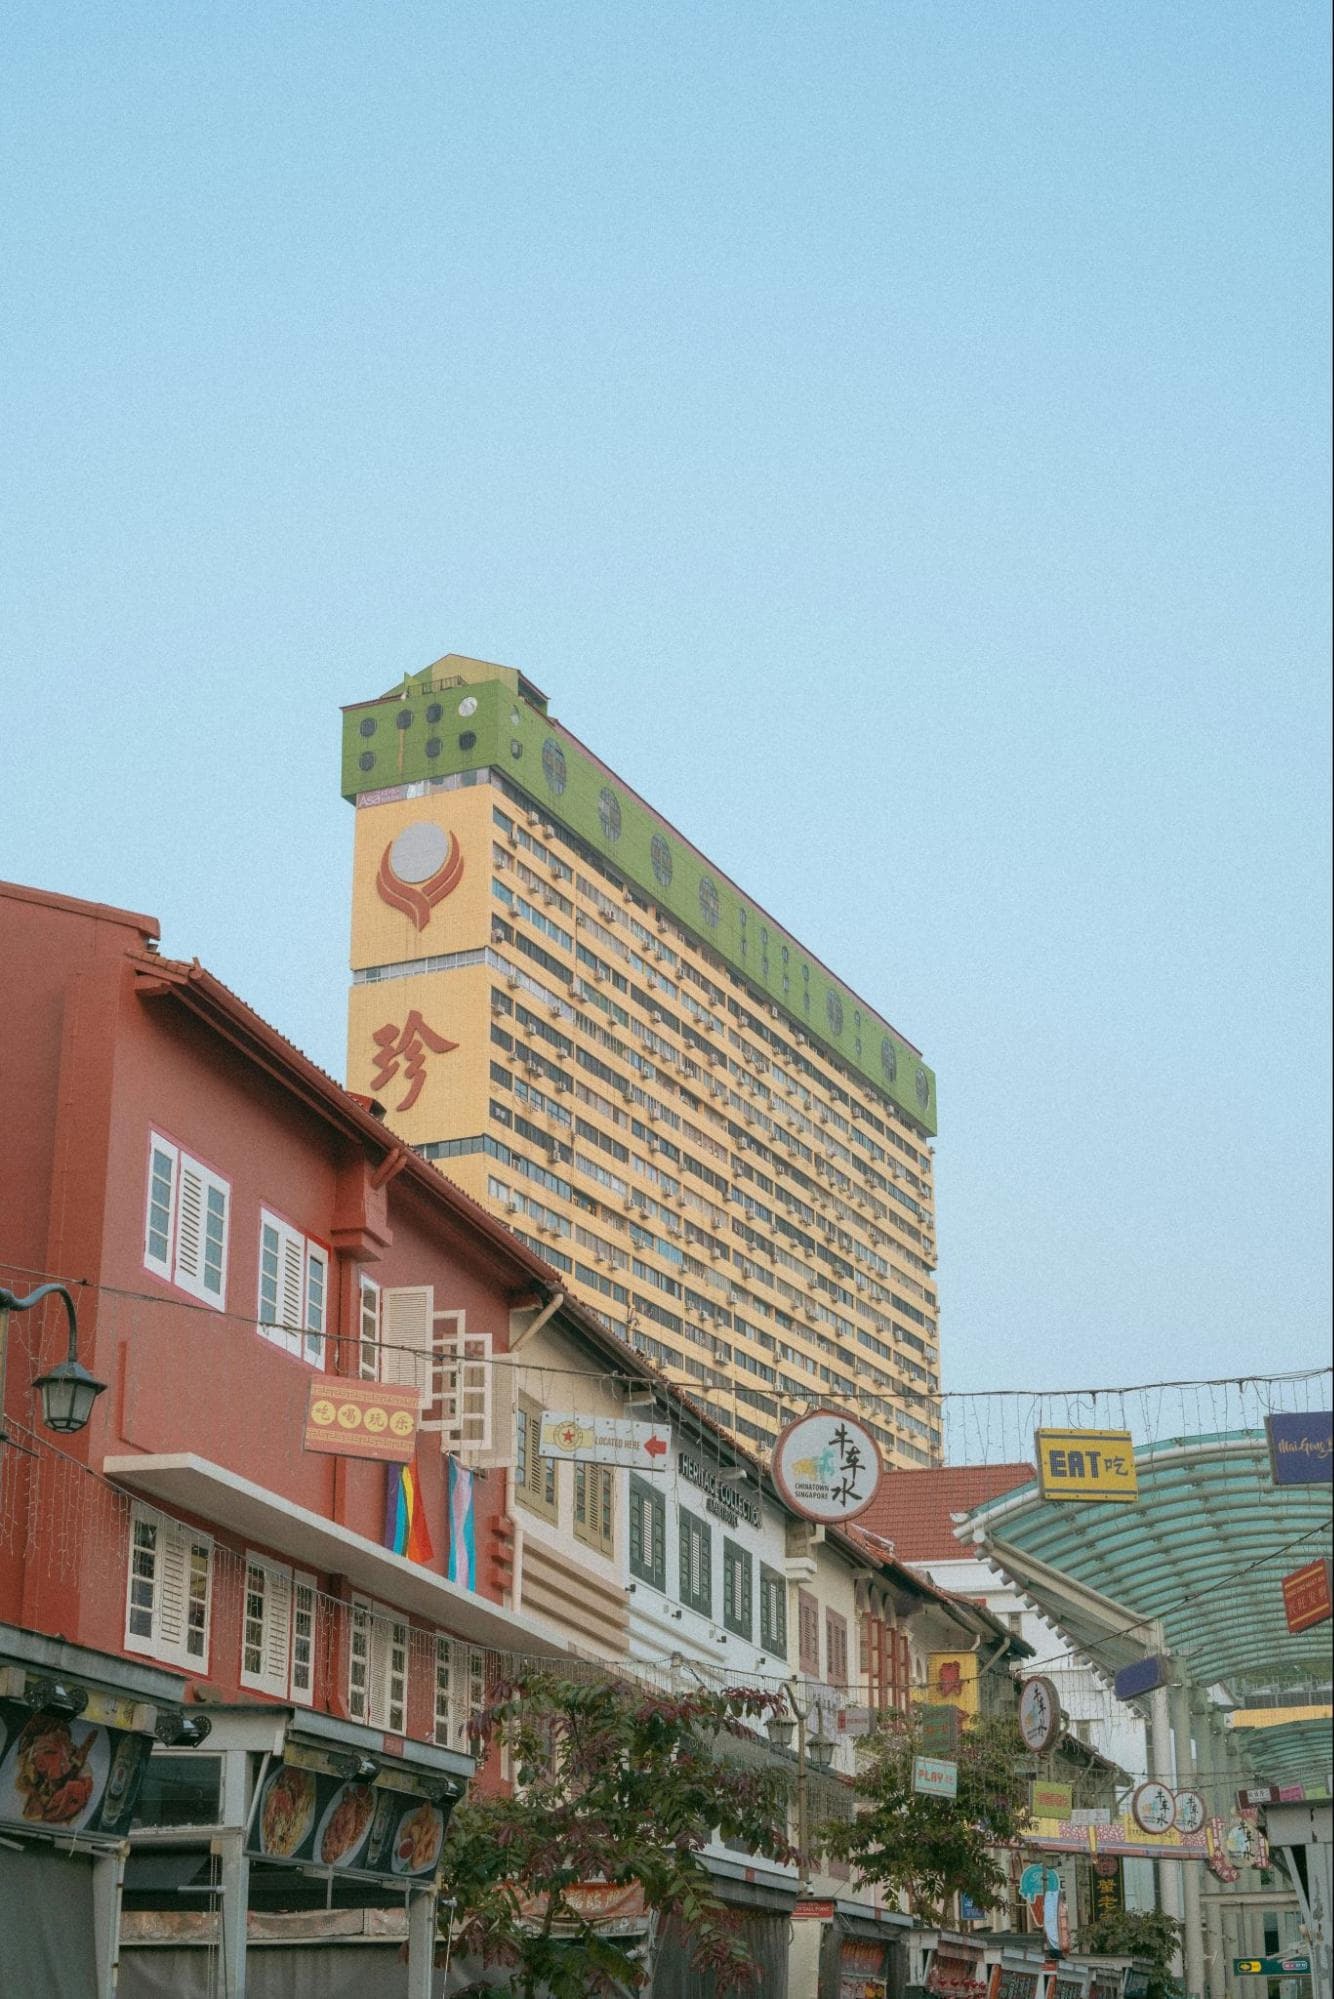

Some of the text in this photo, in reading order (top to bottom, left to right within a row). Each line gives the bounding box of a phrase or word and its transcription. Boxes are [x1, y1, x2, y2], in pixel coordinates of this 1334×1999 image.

[370, 1009, 460, 1112] 珍
[315, 1404, 408, 1431] 吃喝玩乐
[594, 1436, 623, 1449] LOCATED
[1049, 1450, 1129, 1478] EAT 吃
[794, 1482, 830, 1492] CHINATOWN
[794, 1491, 829, 1500] SINGAPORE
[917, 1769, 944, 1784] PLAY
